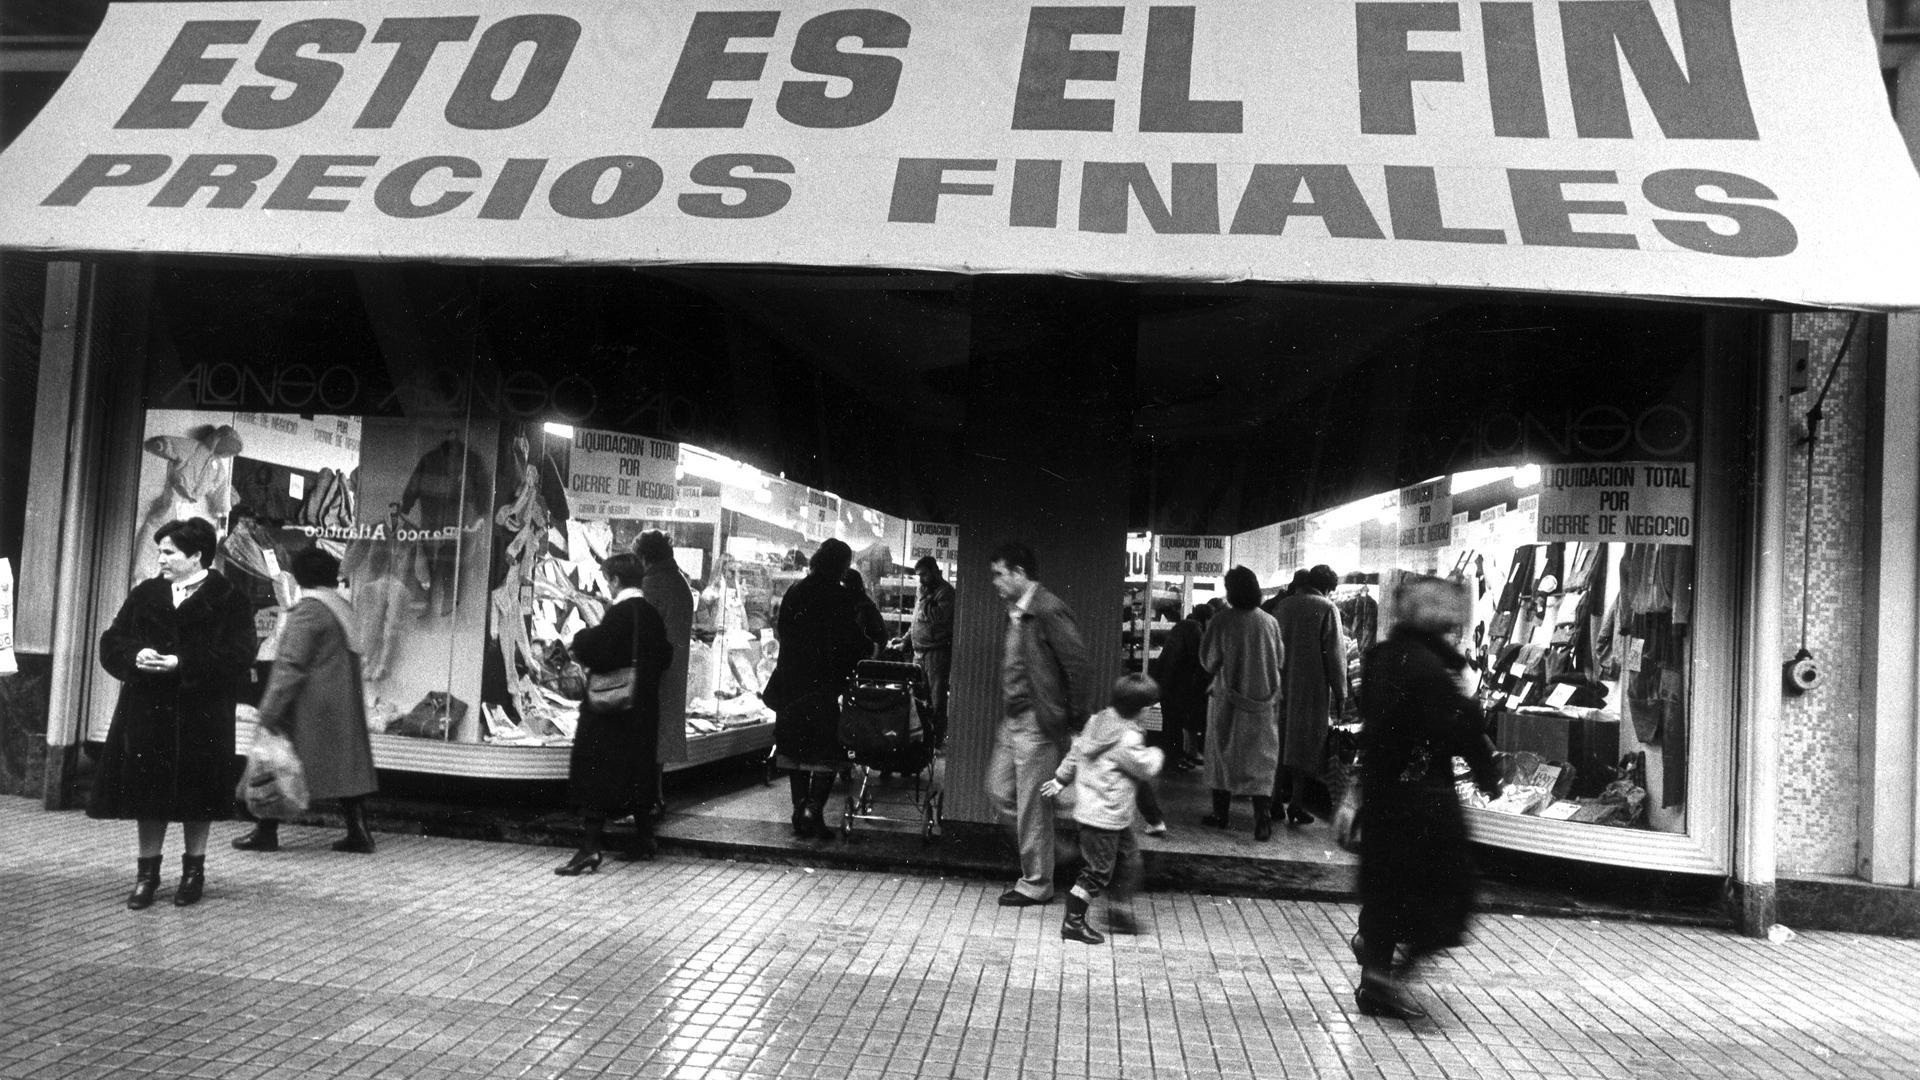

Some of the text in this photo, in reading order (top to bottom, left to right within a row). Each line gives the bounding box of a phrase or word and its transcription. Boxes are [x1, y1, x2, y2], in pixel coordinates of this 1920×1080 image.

[114, 0, 1759, 139] ESTO ES EL FIN
[41, 153, 1797, 258] PRECIOS FINALES
[160, 362, 360, 409] ALONSO
[575, 429, 676, 462] LIQUIDACION TOTAL
[619, 457, 640, 477] POR
[1542, 466, 1690, 492] LIQUIDACION TOTAL
[572, 473, 612, 495] CIERRE
[618, 479, 631, 497] DE
[636, 481, 675, 501] NEGOCIO
[1600, 491, 1630, 512] POR
[1541, 514, 1690, 537] CIERRE DE NEGOCIO
[1160, 537, 1224, 550] LIQUIDACION TOTAL
[1185, 550, 1198, 561] POR
[1160, 561, 1181, 572] CIERRE
[1184, 562, 1192, 572] DE
[1195, 562, 1223, 573] NEGOCIO
